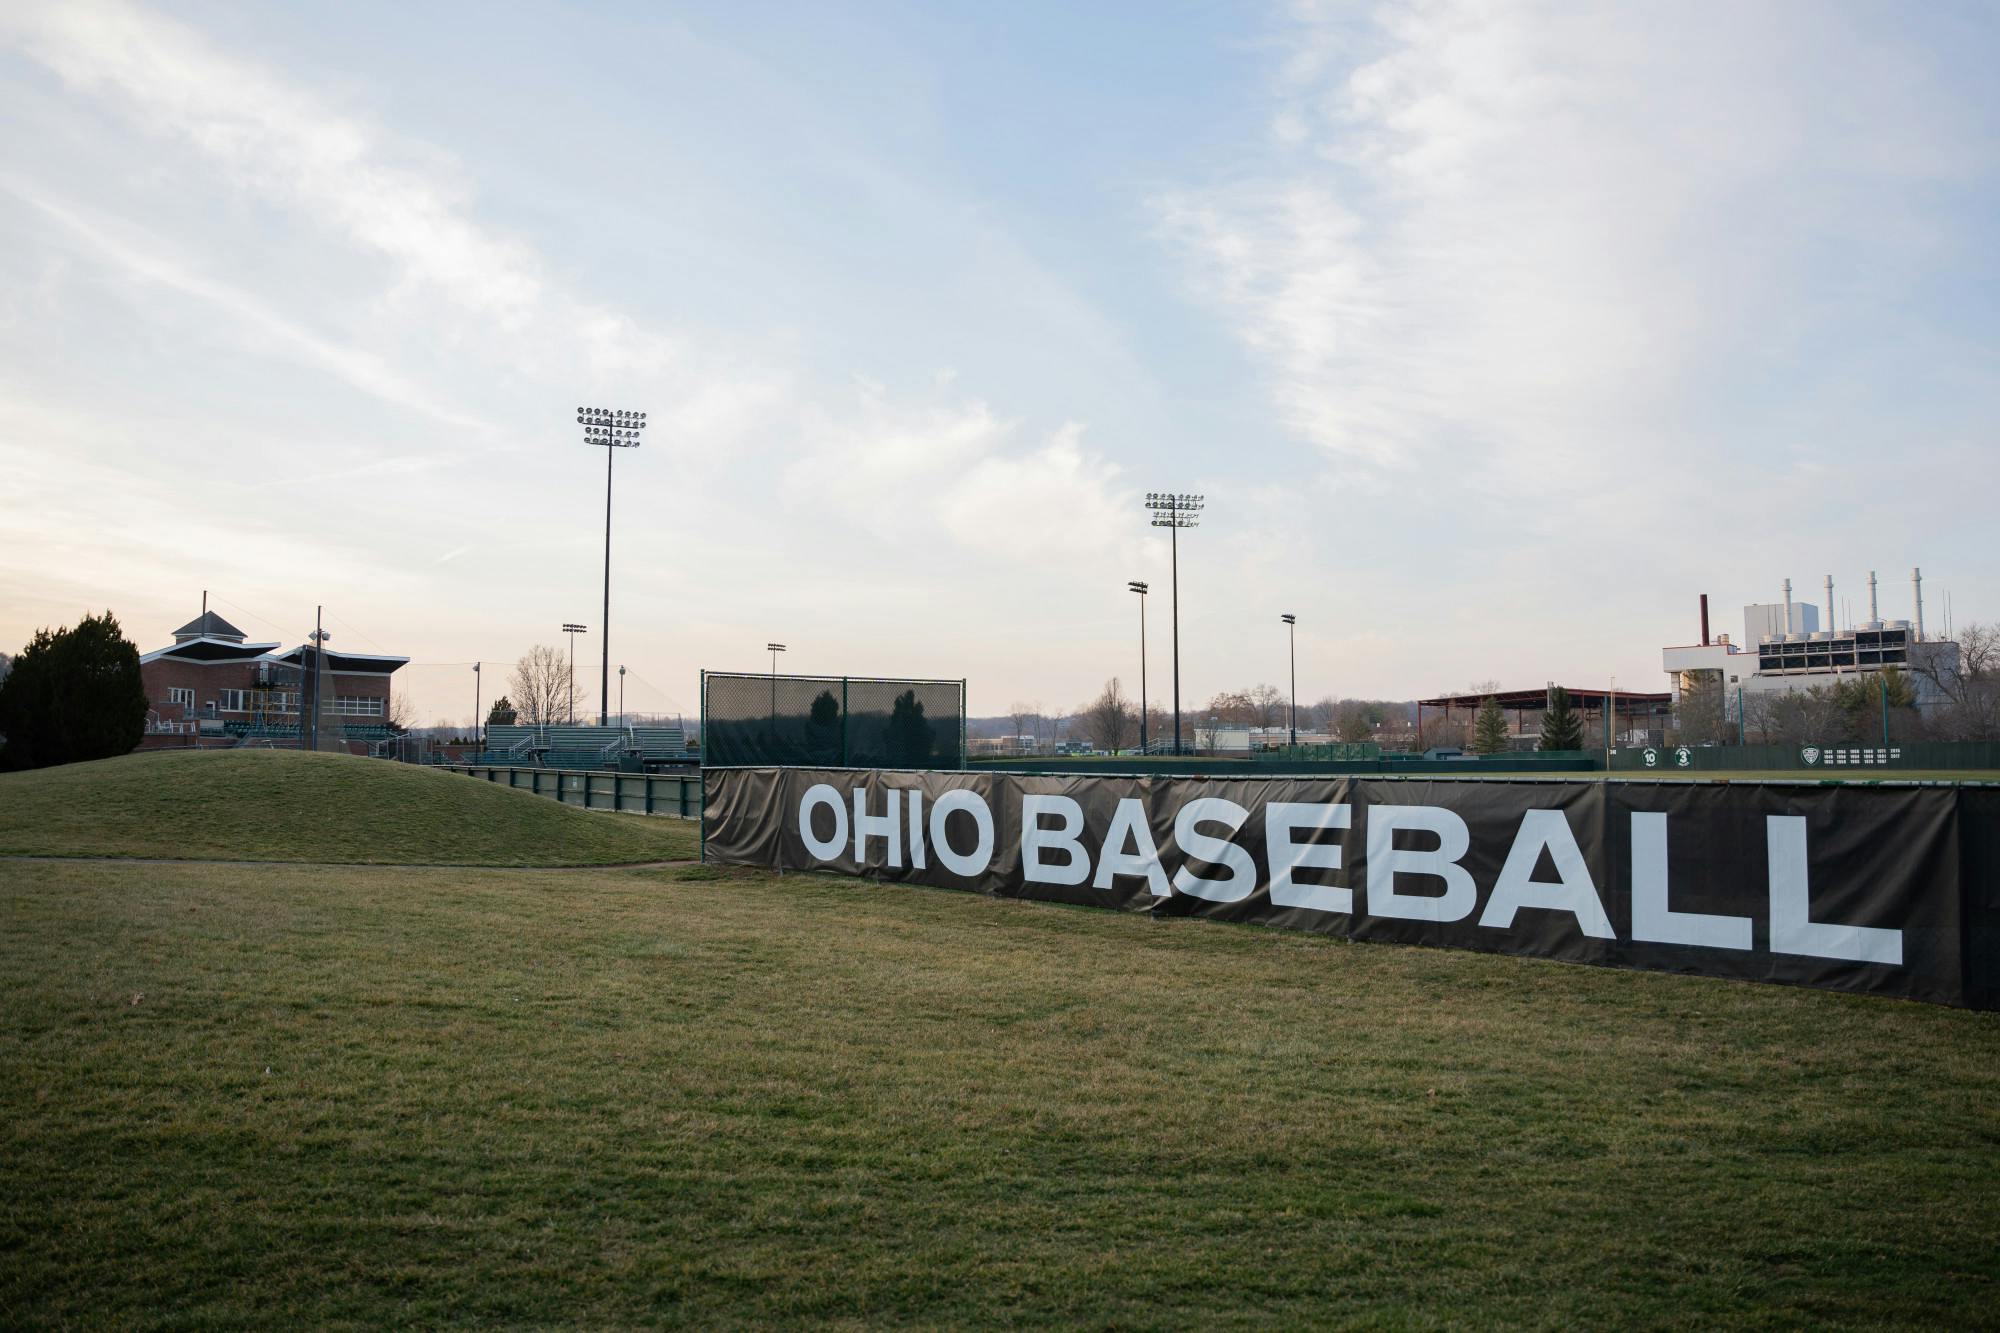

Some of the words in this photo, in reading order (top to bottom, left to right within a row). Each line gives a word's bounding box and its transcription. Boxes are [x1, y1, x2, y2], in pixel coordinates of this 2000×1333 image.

[1645, 753, 1656, 763] 10
[1680, 750, 1688, 763] 3
[799, 783, 995, 877] OHIO
[1021, 793, 1903, 965] BASEBALL
